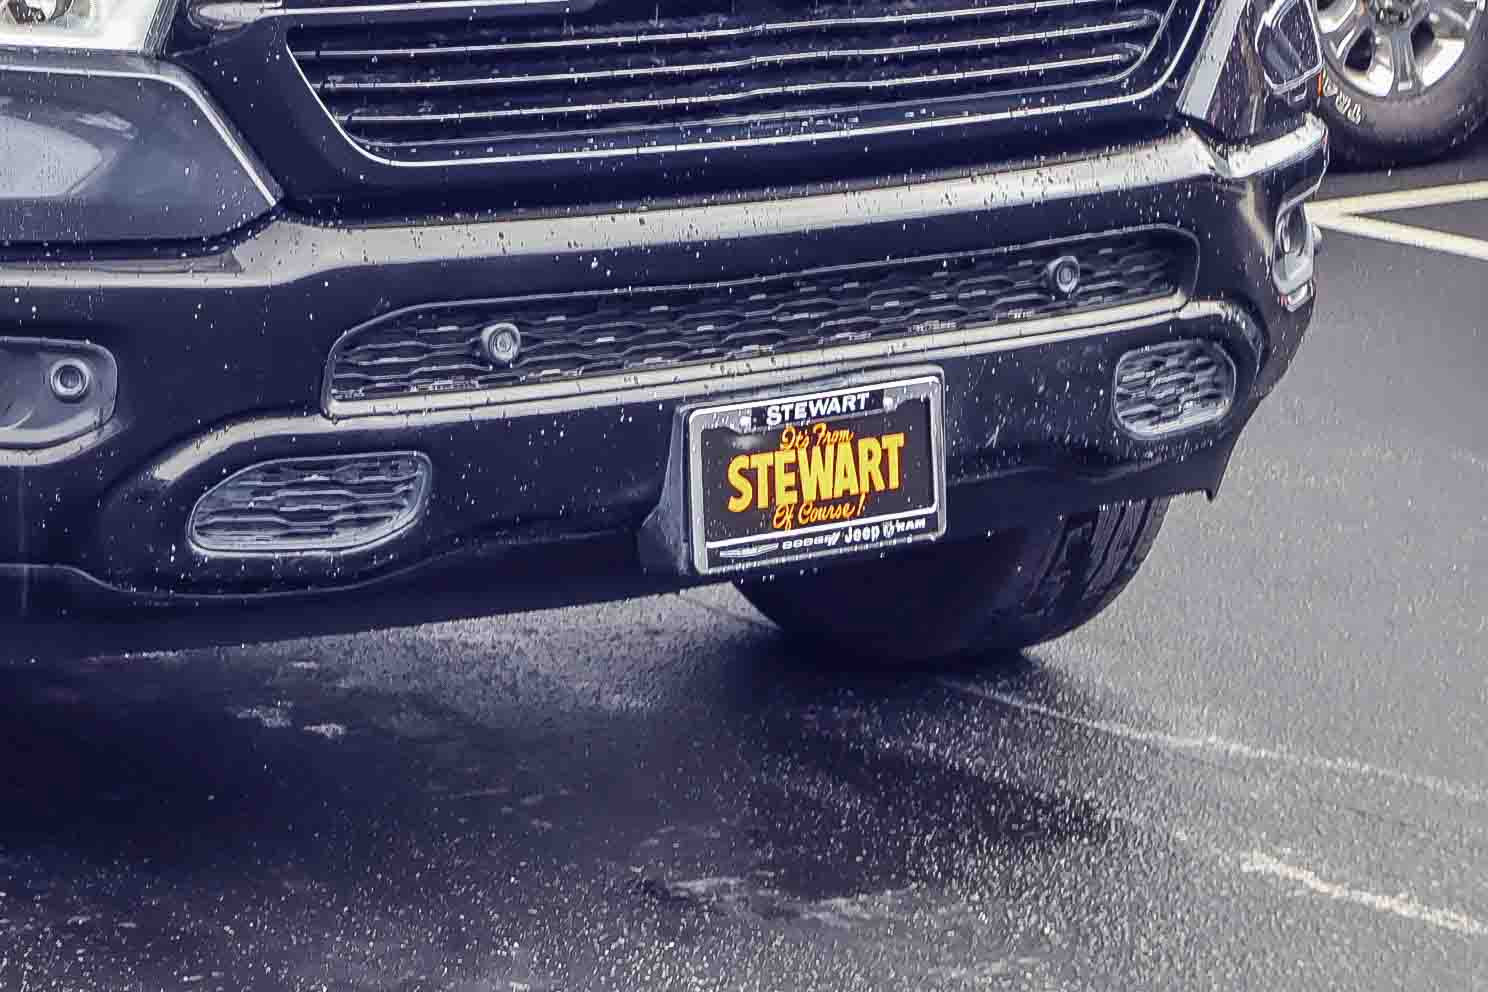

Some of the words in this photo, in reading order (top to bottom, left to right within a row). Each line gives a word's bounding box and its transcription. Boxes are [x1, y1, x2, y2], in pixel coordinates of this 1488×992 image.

[766, 392, 870, 427] STEWART
[812, 422, 855, 448] From
[726, 432, 906, 513] STEWART
[844, 525, 881, 545] Jeep
